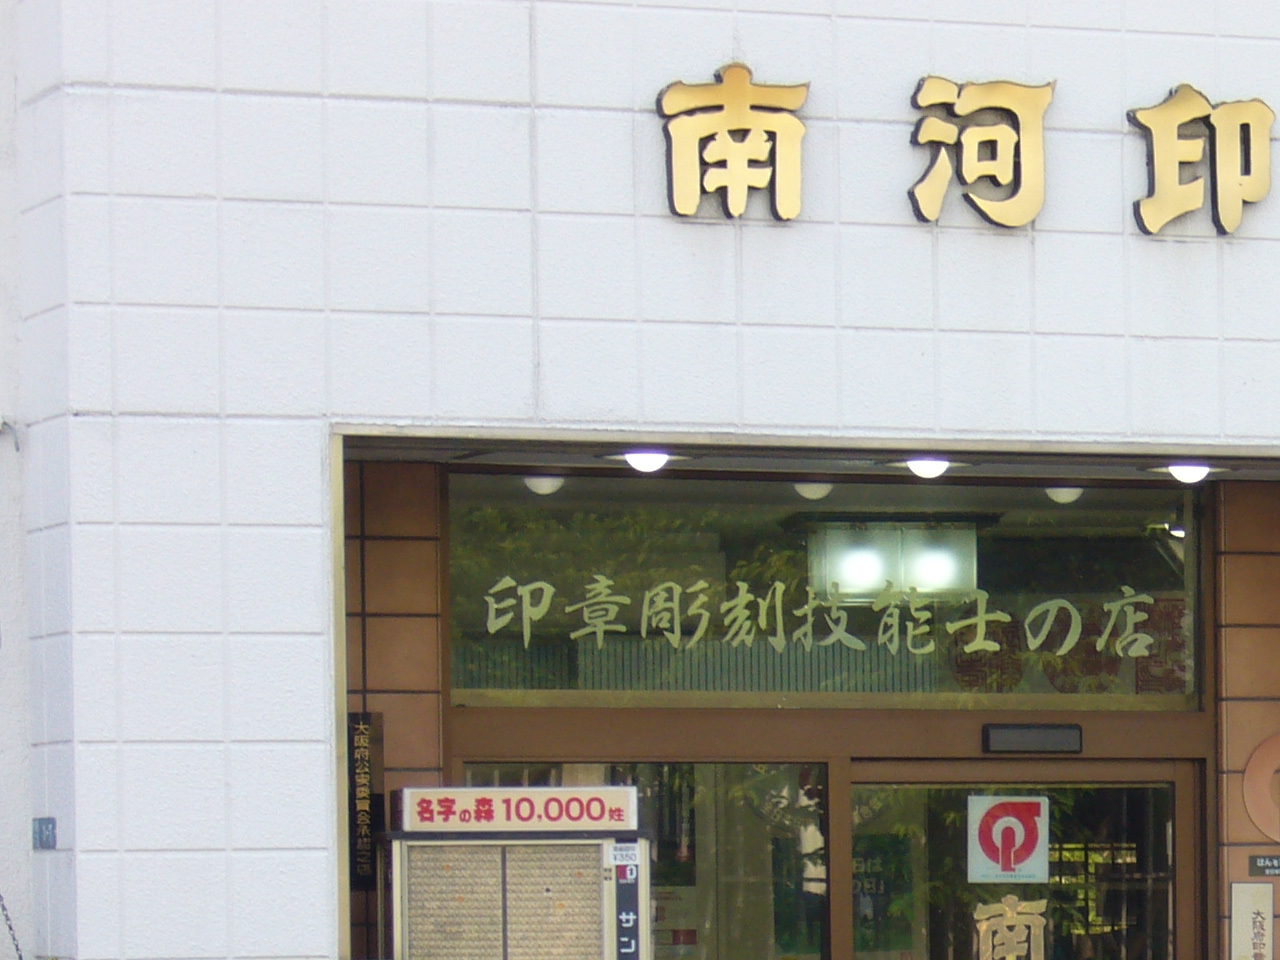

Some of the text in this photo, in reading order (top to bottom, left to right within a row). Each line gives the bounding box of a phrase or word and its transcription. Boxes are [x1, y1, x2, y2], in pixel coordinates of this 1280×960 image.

[485, 574, 1156, 659] 印章彫刻技能士の店
[416, 797, 625, 823] 名字の森 10,000姓
